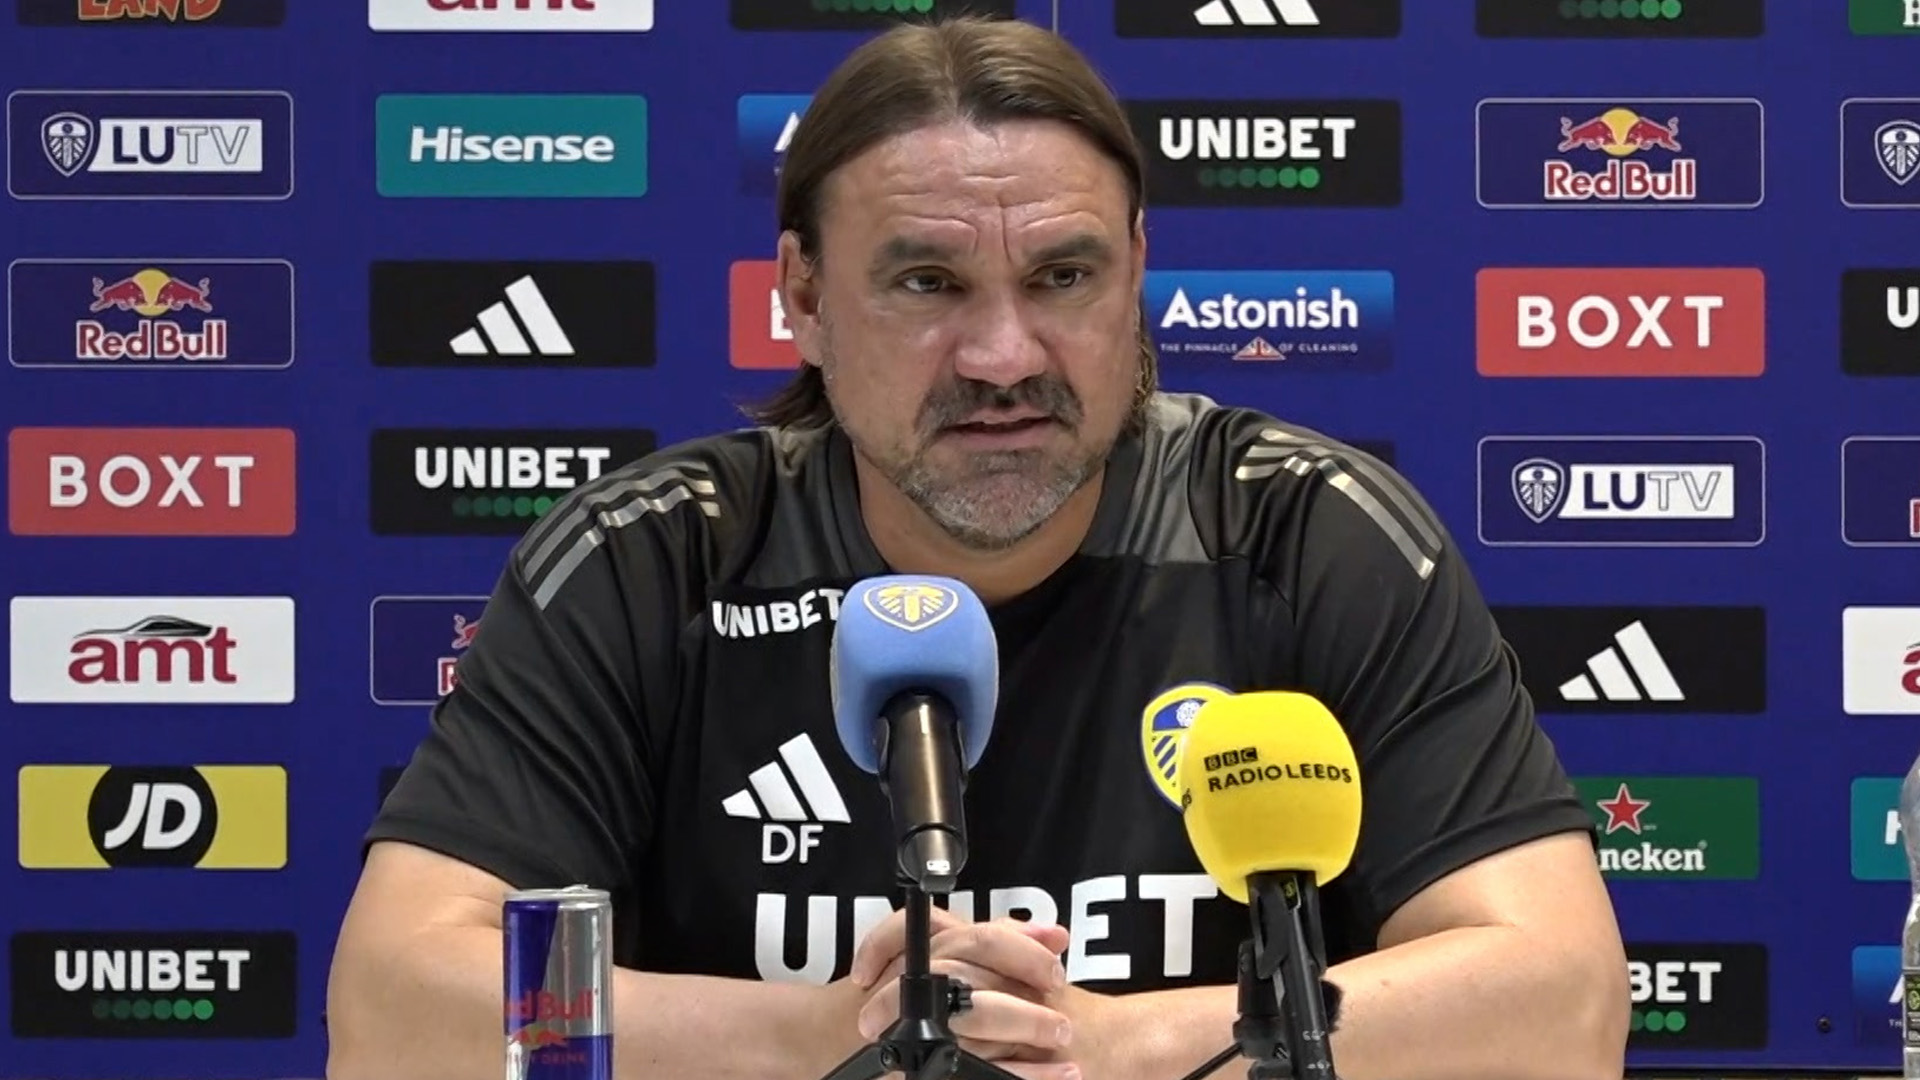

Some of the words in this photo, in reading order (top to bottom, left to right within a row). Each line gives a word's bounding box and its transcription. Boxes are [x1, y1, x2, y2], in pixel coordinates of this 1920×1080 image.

[112, 126, 250, 165] LUTV
[410, 126, 615, 163] Hisense
[1159, 117, 1356, 161] UNIBET
[1544, 159, 1620, 200] Red
[1622, 159, 1696, 200] Bull
[1159, 286, 1359, 330] Astonish
[1516, 295, 1724, 349] BOXT
[76, 320, 150, 360] Red
[154, 320, 227, 360] Bull
[1160, 343, 1180, 354] THE
[1184, 343, 1238, 354] PINNACLE
[1278, 343, 1294, 354] OF
[1299, 343, 1359, 354] CLEANING
[48, 455, 255, 508] BOXT
[414, 446, 611, 489] UNIBET
[1583, 471, 1721, 512] LUTV
[711, 588, 845, 639] UNIBET
[67, 626, 238, 684] amt
[1203, 746, 1259, 772] BBC
[1207, 764, 1283, 793] RADIO
[1285, 763, 1352, 784] LEEDS
[104, 783, 203, 849] JD
[761, 824, 824, 864] DF
[1598, 841, 1706, 871] neken
[755, 874, 1218, 984] UET
[54, 950, 250, 991] UNIBET
[1626, 961, 1722, 1003] BET
[536, 988, 594, 1020] Bull
